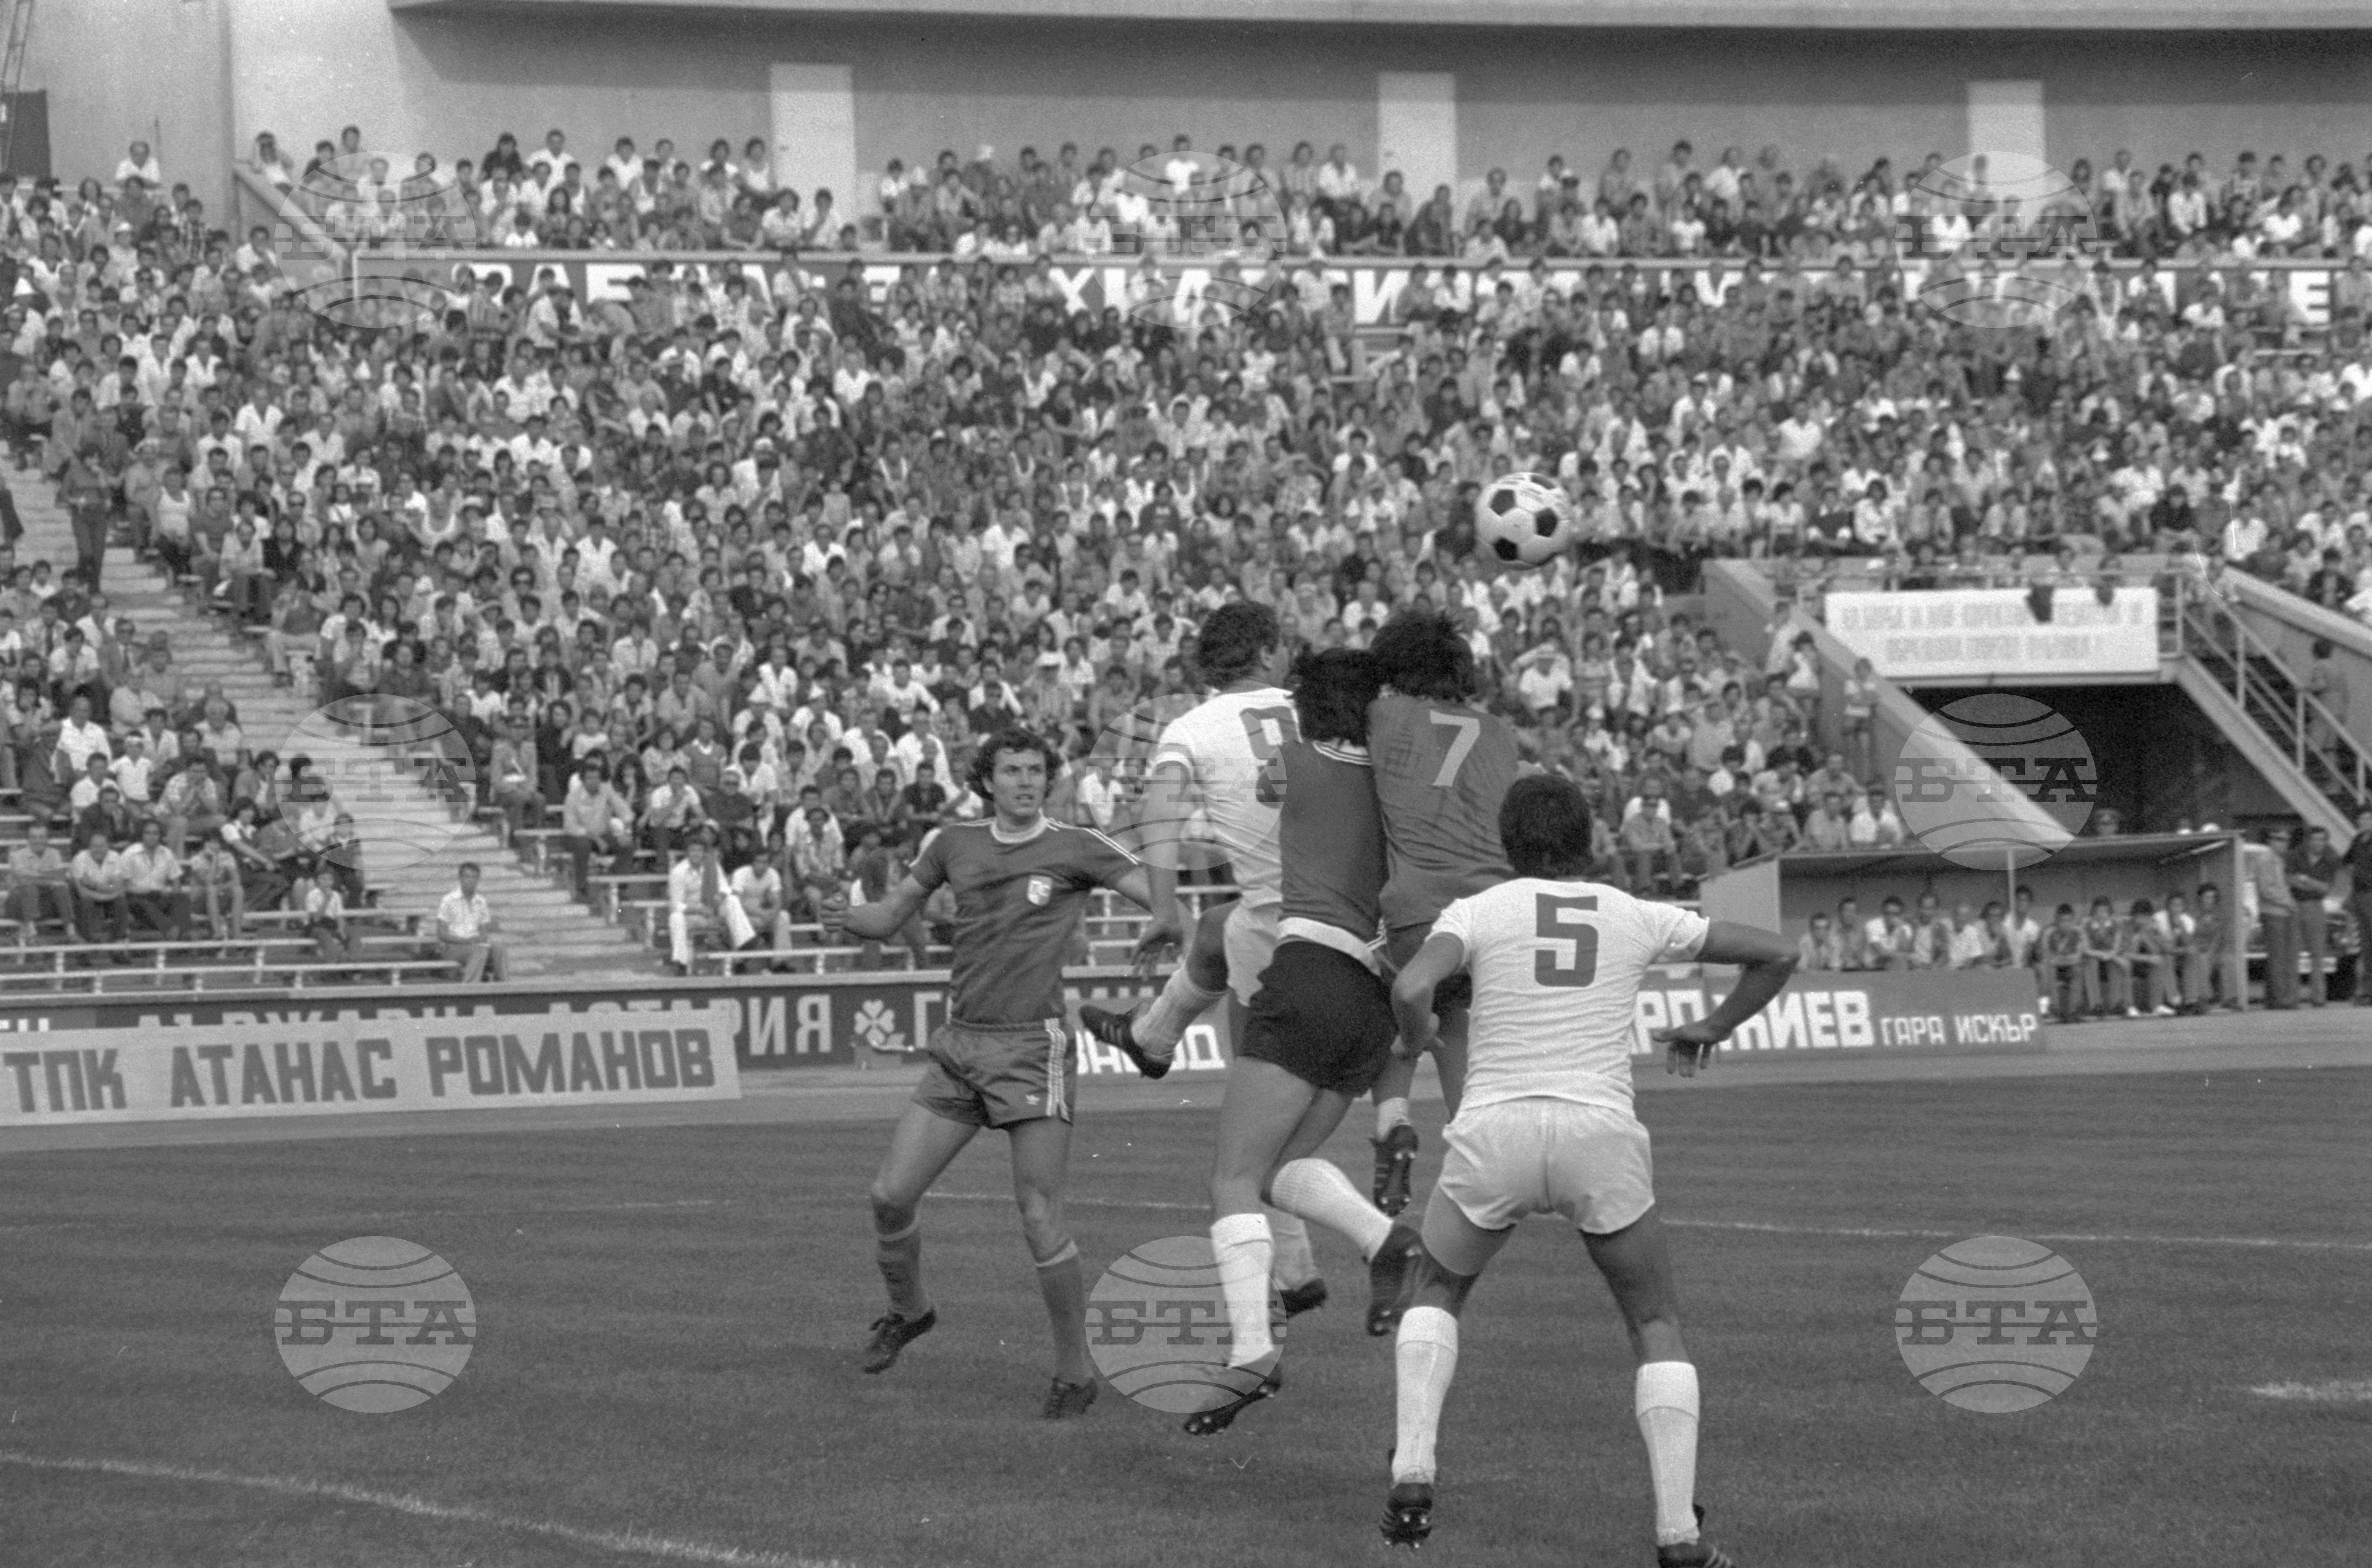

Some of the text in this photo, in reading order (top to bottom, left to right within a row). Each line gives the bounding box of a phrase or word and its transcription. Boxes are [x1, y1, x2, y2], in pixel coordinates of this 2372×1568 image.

[1429, 710, 1481, 786] 7
[1535, 892, 1599, 988] 5
[1880, 1015, 1946, 1046] ГАРА
[1955, 1013, 2038, 1045] ИСКЪР
[3, 1028, 715, 1113] ТПК АТАНАС РОМАНОВ
